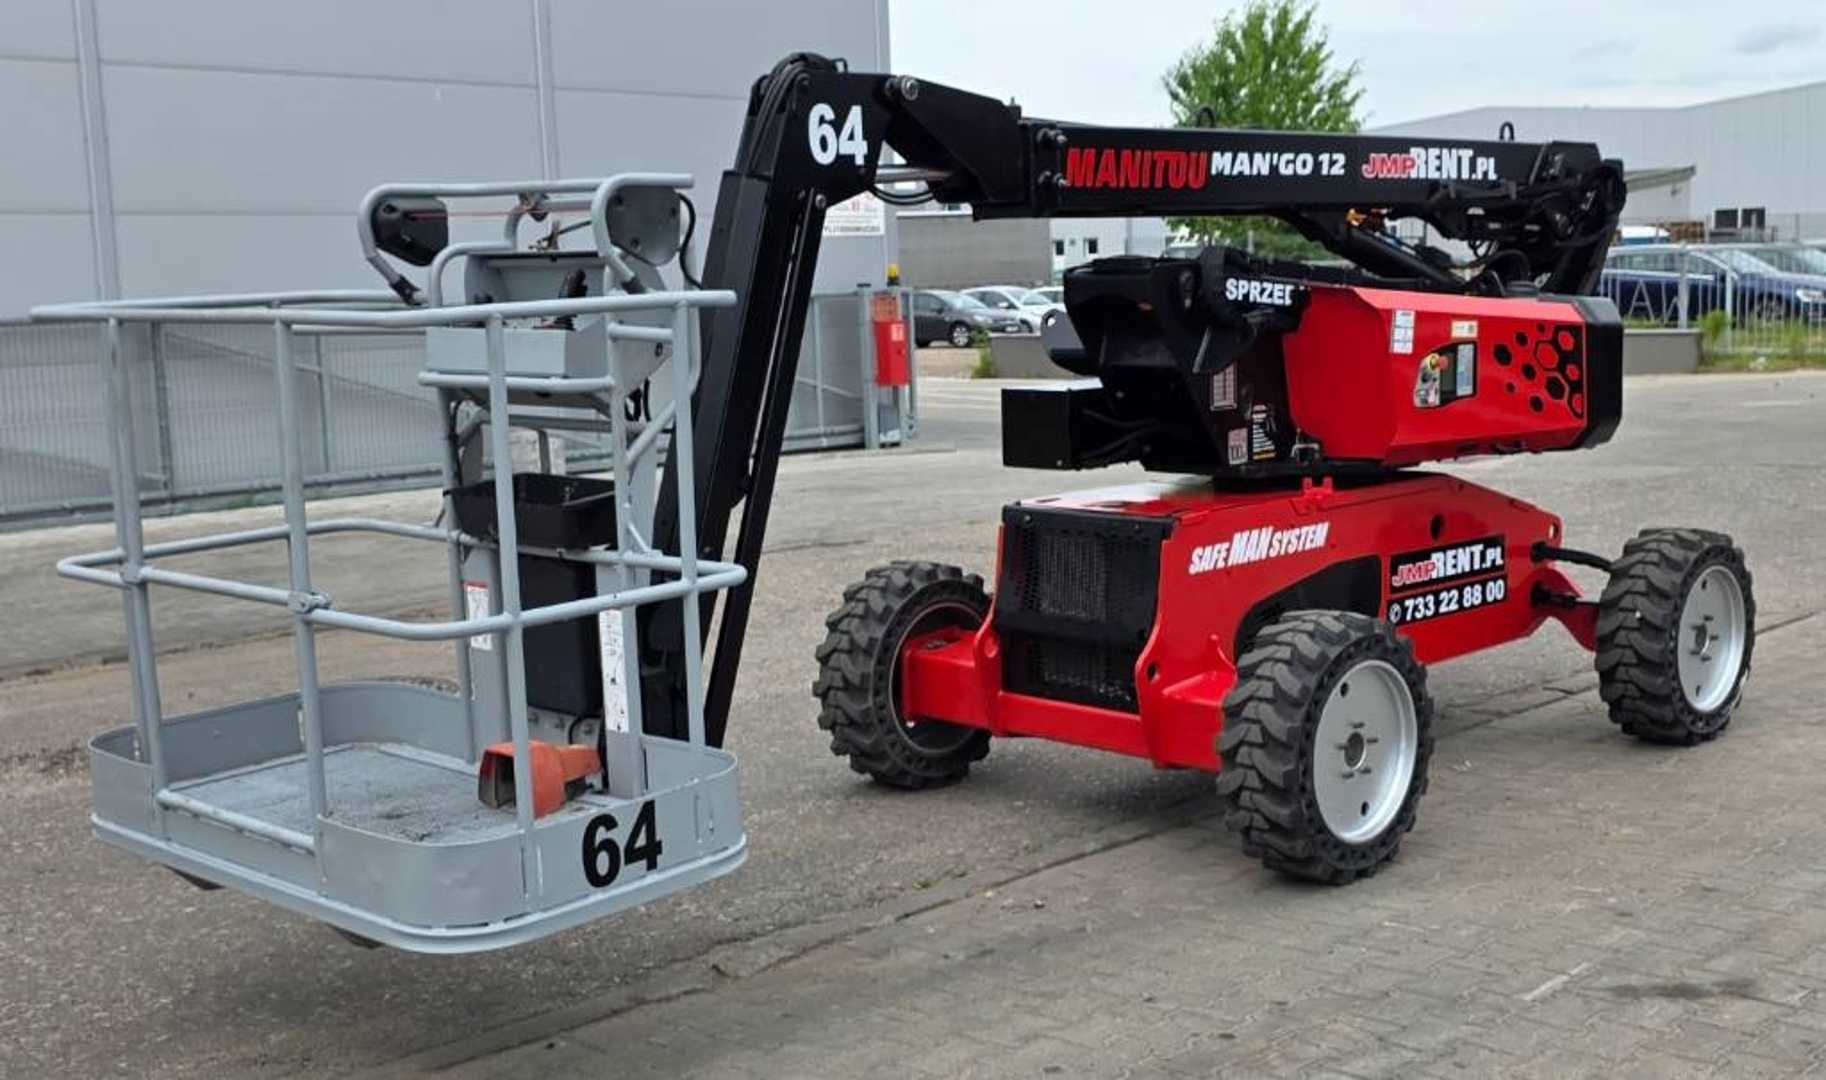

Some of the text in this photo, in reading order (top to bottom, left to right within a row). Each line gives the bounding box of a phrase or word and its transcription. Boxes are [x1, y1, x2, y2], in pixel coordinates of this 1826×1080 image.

[808, 104, 868, 166] 64
[1066, 148, 1346, 189] MANITOU MAN'GO 12
[1190, 522, 1330, 575] SAFE MAN SYSTEM
[1404, 579, 1505, 621] 733 22 88 00
[582, 800, 662, 888] 64
